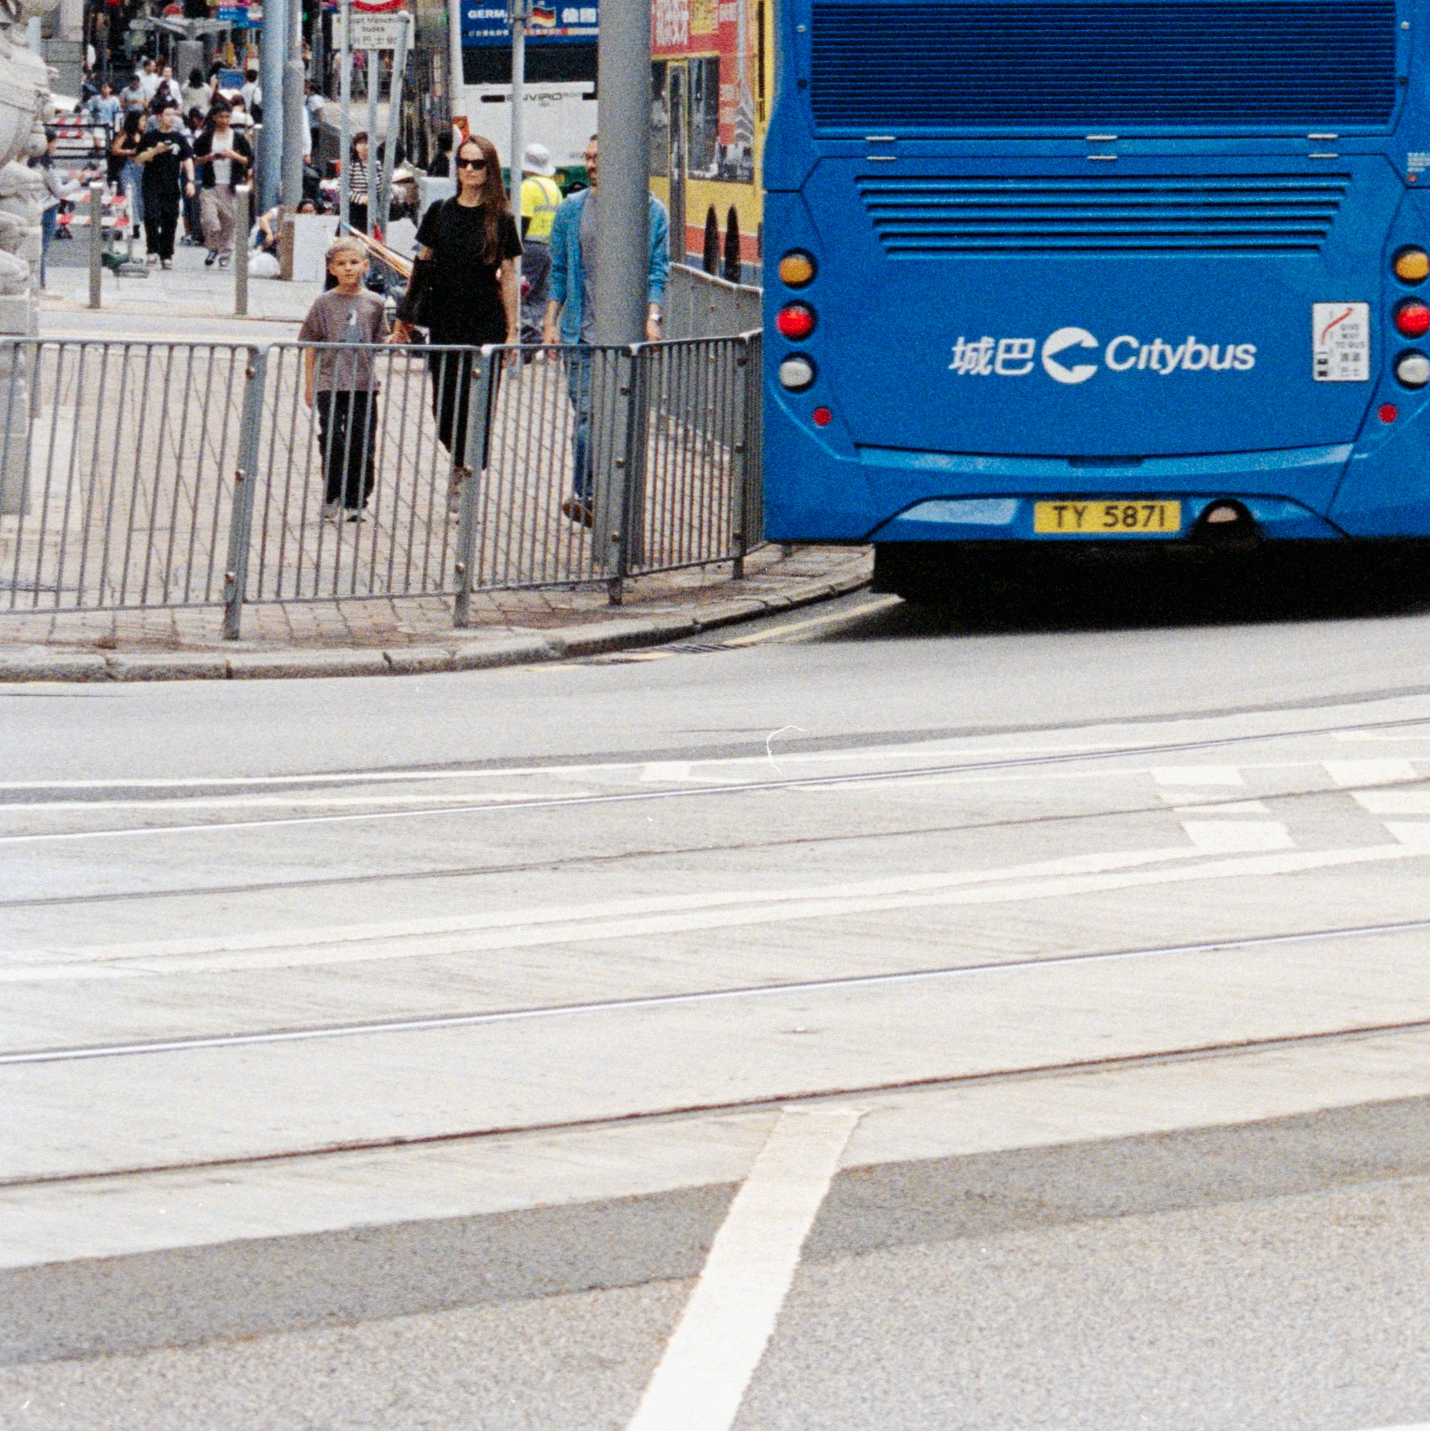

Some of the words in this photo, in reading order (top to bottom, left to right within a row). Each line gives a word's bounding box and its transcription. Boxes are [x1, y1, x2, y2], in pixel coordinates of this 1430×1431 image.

[949, 336, 1036, 375] 城巴
[1105, 335, 1257, 375] Citybus
[1053, 505, 1088, 527] TY
[1103, 505, 1165, 527] 5871
